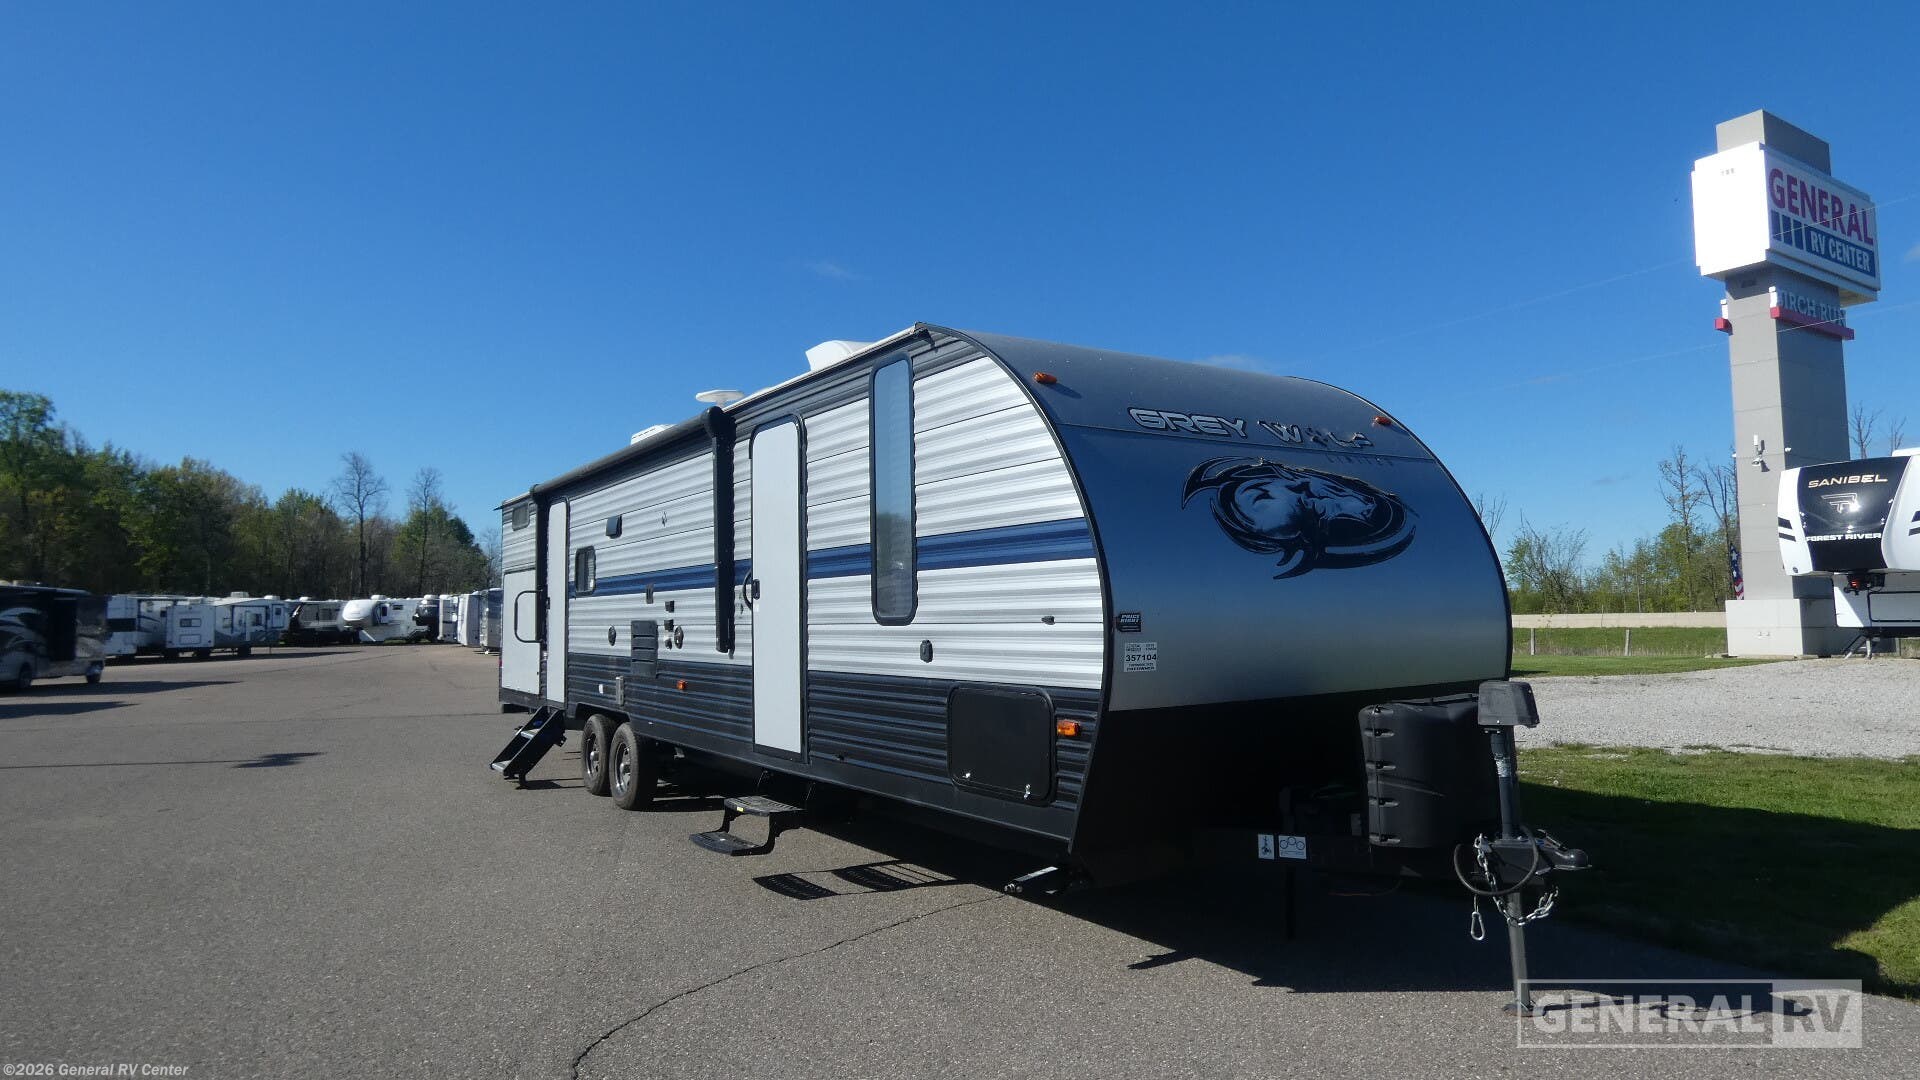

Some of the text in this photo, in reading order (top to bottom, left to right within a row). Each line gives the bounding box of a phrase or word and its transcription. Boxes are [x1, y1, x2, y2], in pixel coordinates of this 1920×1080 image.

[1768, 168, 1874, 246] GENERAL
[1810, 230, 1871, 272] RV CENTER
[1127, 406, 1248, 438] GREY
[1808, 474, 1889, 488] SANIBEL
[1805, 532, 1882, 542] FOREST RIVER
[1125, 654, 1157, 662] 357104
